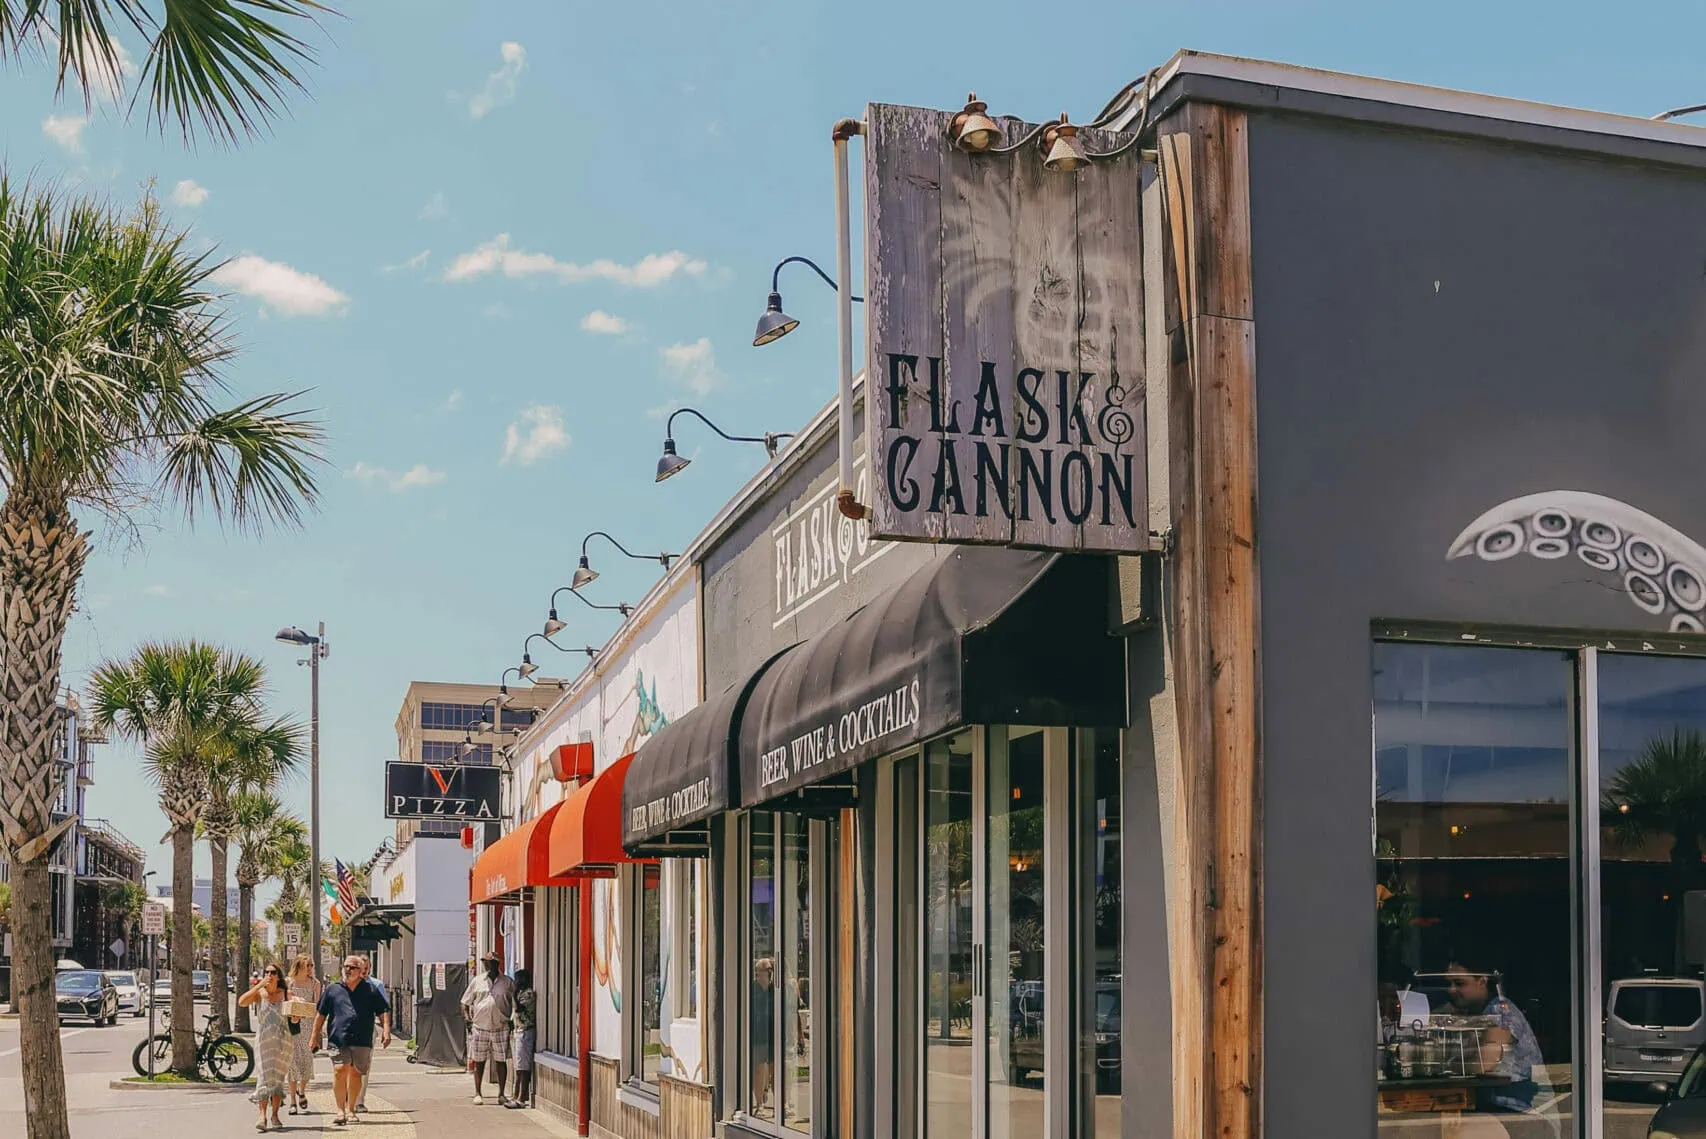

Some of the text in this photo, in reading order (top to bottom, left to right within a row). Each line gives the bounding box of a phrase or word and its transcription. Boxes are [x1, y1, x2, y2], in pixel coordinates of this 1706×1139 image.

[885, 353, 1096, 446] FLASK
[887, 435, 1137, 529] CANNON
[775, 494, 837, 615] FLASK
[761, 679, 920, 788] BEER, WINE & COCKTAILS
[392, 794, 494, 818] PIZZA
[632, 776, 710, 833] BEER, WINE & COCKTAILS
[286, 934, 298, 943] 15
